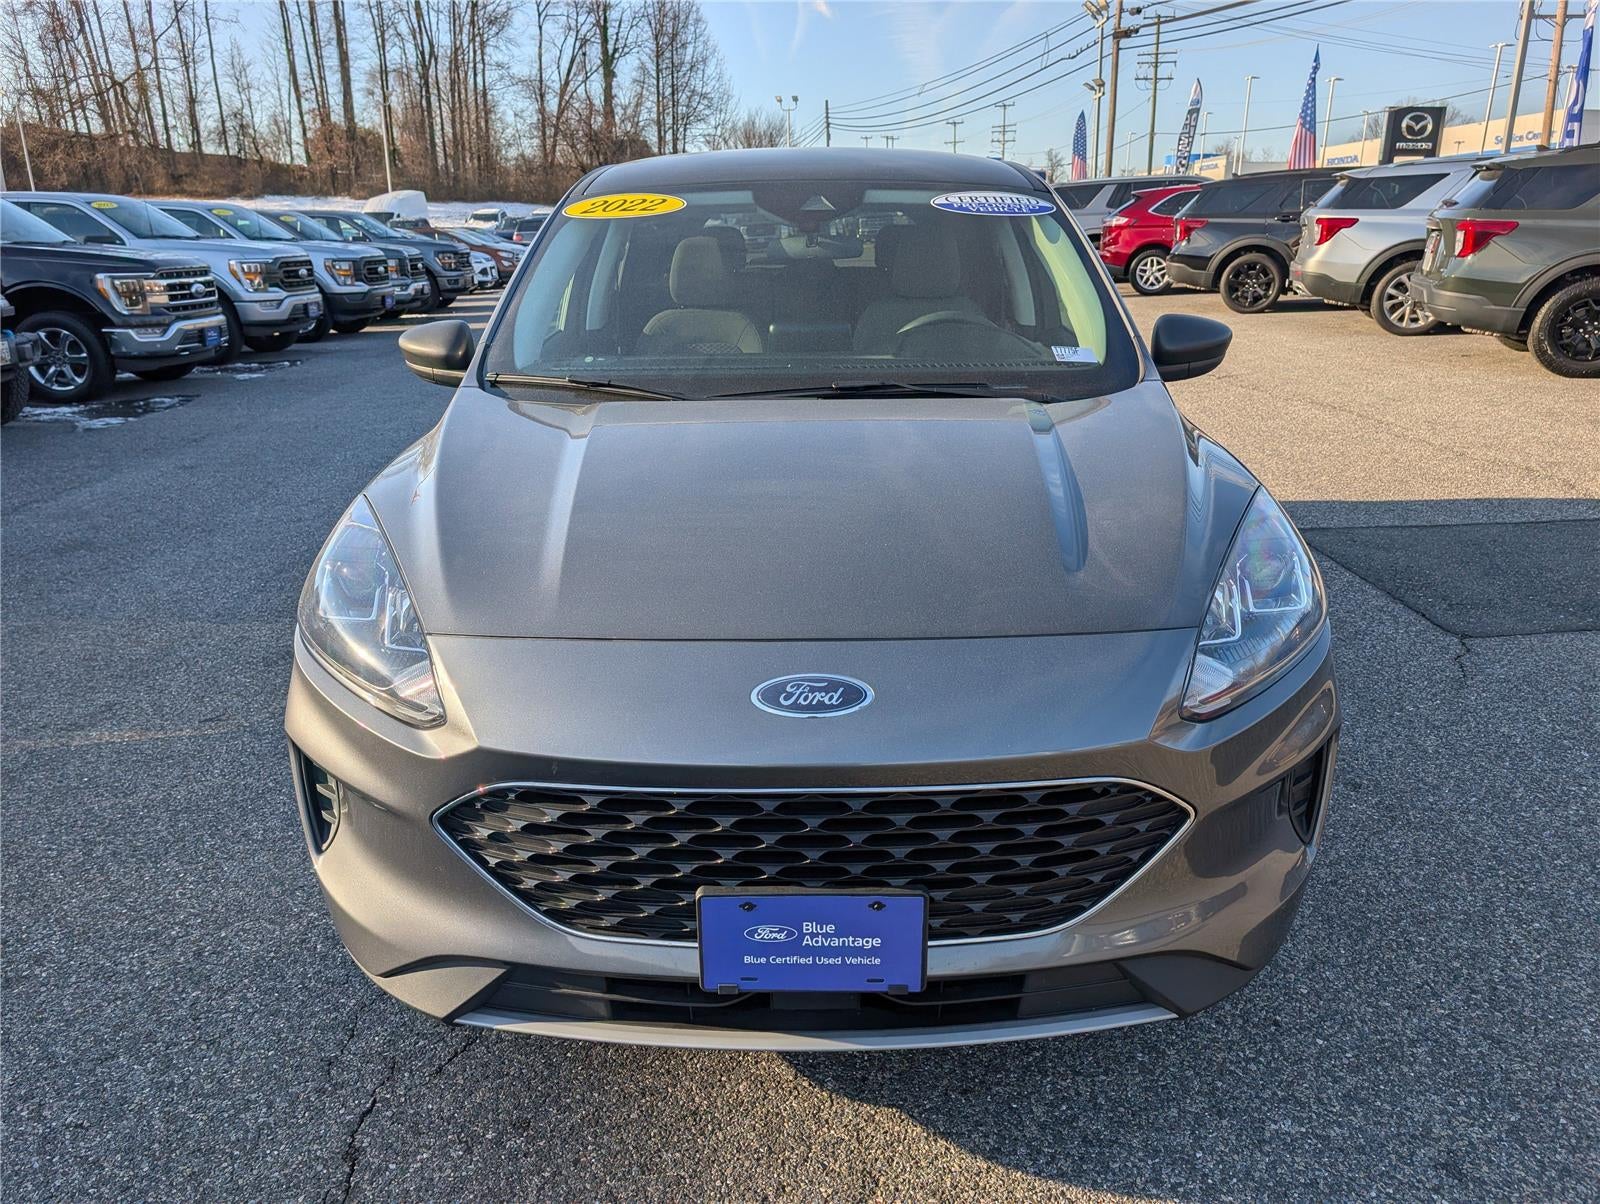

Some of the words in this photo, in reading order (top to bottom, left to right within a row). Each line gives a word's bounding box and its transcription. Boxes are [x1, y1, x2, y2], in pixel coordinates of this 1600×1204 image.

[1395, 142, 1433, 150] mazda
[1327, 154, 1359, 166] HONDA
[580, 198, 668, 215] 2022
[944, 195, 1040, 206] CERTIFIED
[968, 206, 1031, 214] VEHICLE
[779, 681, 845, 706] Ford
[802, 921, 836, 934] Blue
[754, 927, 788, 941] Ford
[801, 935, 882, 949] Advantage
[744, 955, 767, 965] Blue
[769, 955, 813, 965] Certified
[815, 955, 842, 965] Used
[844, 955, 881, 966] Vehicle
